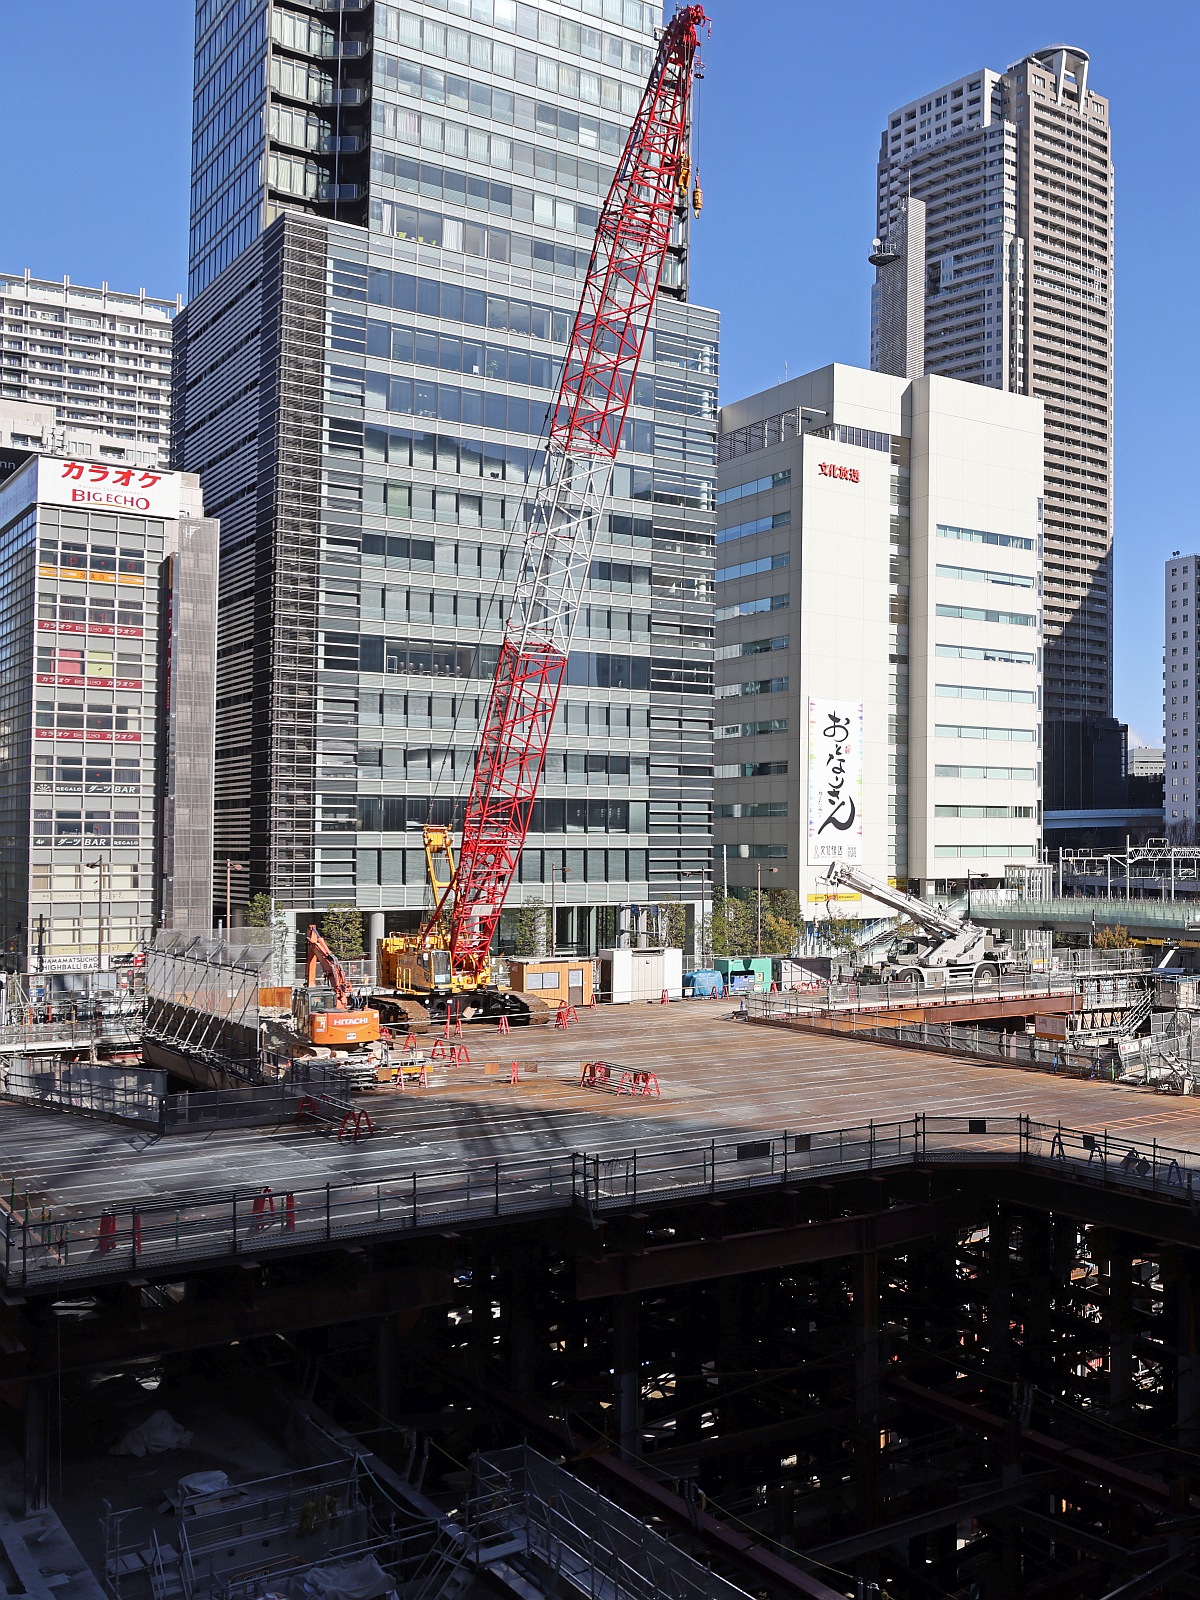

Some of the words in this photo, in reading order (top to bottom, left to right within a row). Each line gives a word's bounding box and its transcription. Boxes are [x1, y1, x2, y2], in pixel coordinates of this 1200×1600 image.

[61, 462, 162, 489] カラオケ
[818, 462, 861, 483] 文化放送
[72, 488, 103, 502] BIG
[106, 493, 151, 510] ECHO
[42, 622, 72, 630] カラオケ
[108, 627, 136, 635] カラオケ
[88, 785, 111, 793] ダーツ
[114, 785, 136, 793] BAR
[57, 838, 81, 846] ダーツ
[84, 838, 106, 846] BAR
[43, 963, 81, 971] HIGHBALL
[333, 1017, 369, 1026] HITACHI
